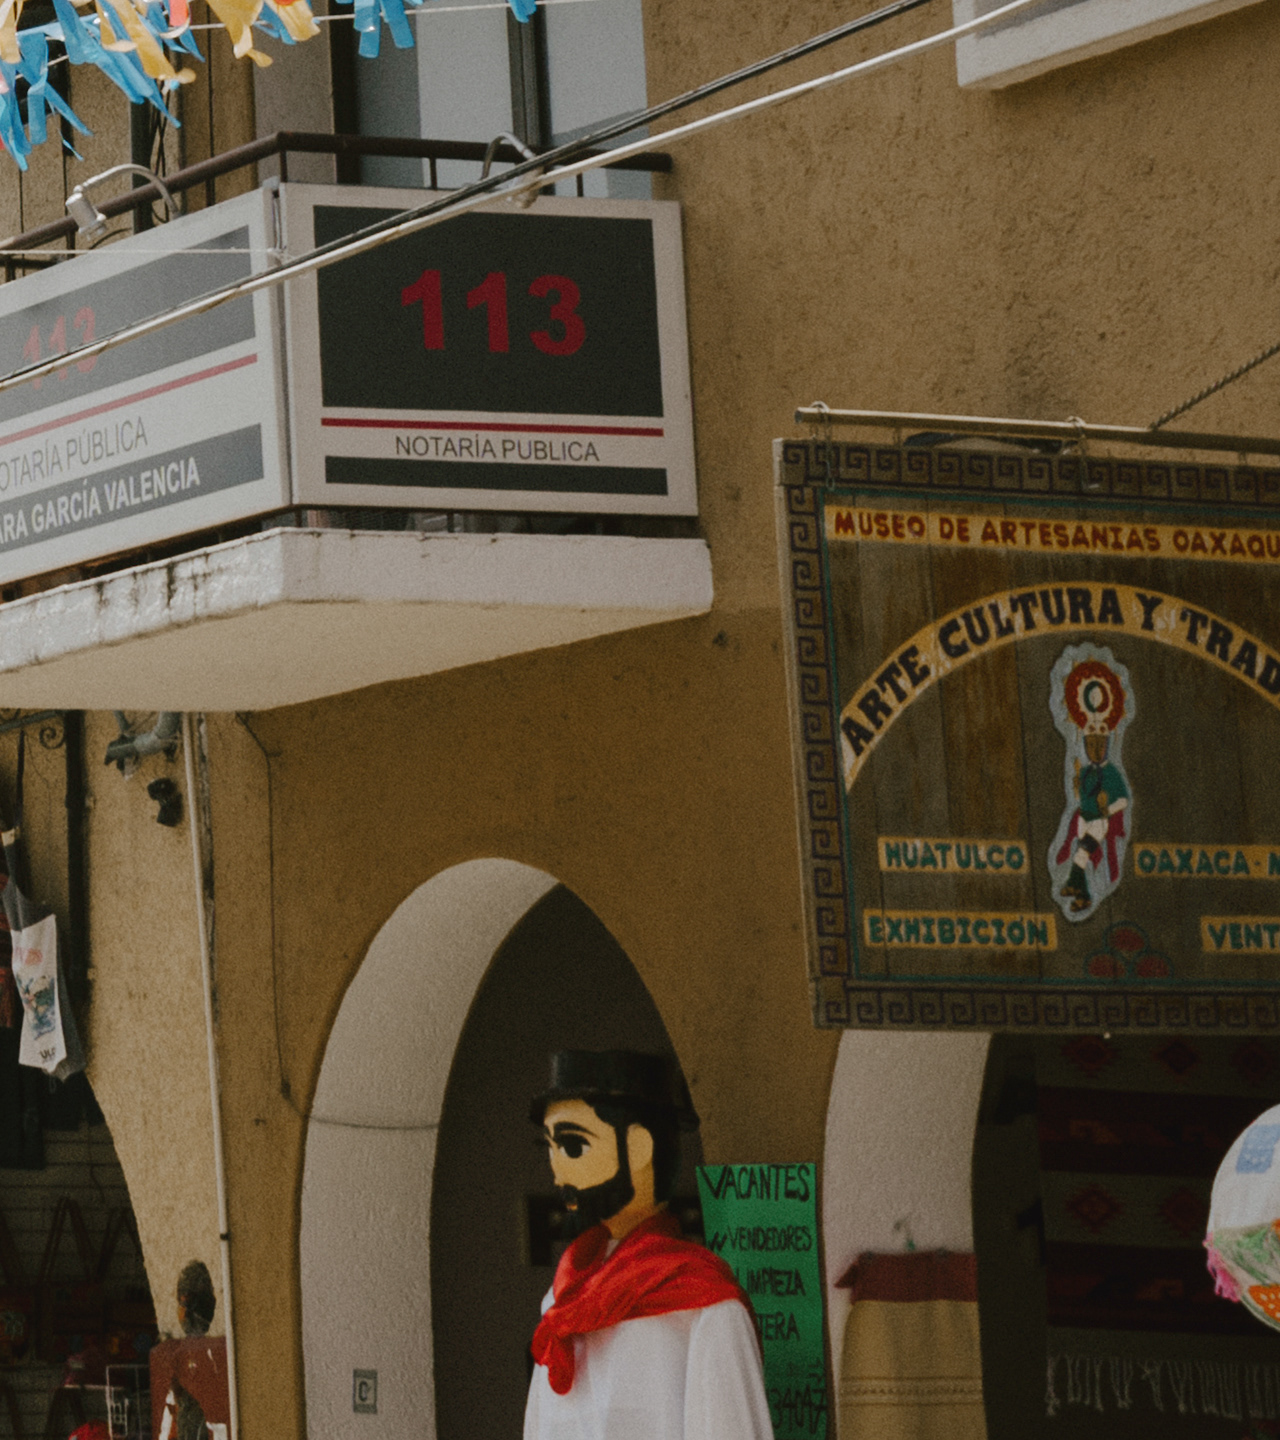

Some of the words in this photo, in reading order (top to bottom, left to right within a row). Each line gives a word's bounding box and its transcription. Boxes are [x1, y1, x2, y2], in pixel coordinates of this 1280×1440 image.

[400, 269, 586, 355] 113
[23, 306, 99, 390] 113
[66, 416, 148, 470] PÚBLICA
[395, 433, 497, 458] NOTARÍA
[502, 438, 600, 461] PUBLICA
[31, 479, 101, 533] GARCÍA
[104, 457, 200, 511] VALENCIA
[834, 511, 926, 540] MUSEO
[939, 517, 970, 542] DE
[981, 519, 1161, 553] ARTESANIAS
[841, 646, 932, 756] ARTE
[938, 586, 1124, 662] CULTURA
[1134, 592, 1164, 631] Y
[884, 842, 1026, 870] HUATULCO
[1137, 848, 1251, 875] OAXACA
[700, 1164, 811, 1201] VACANTES
